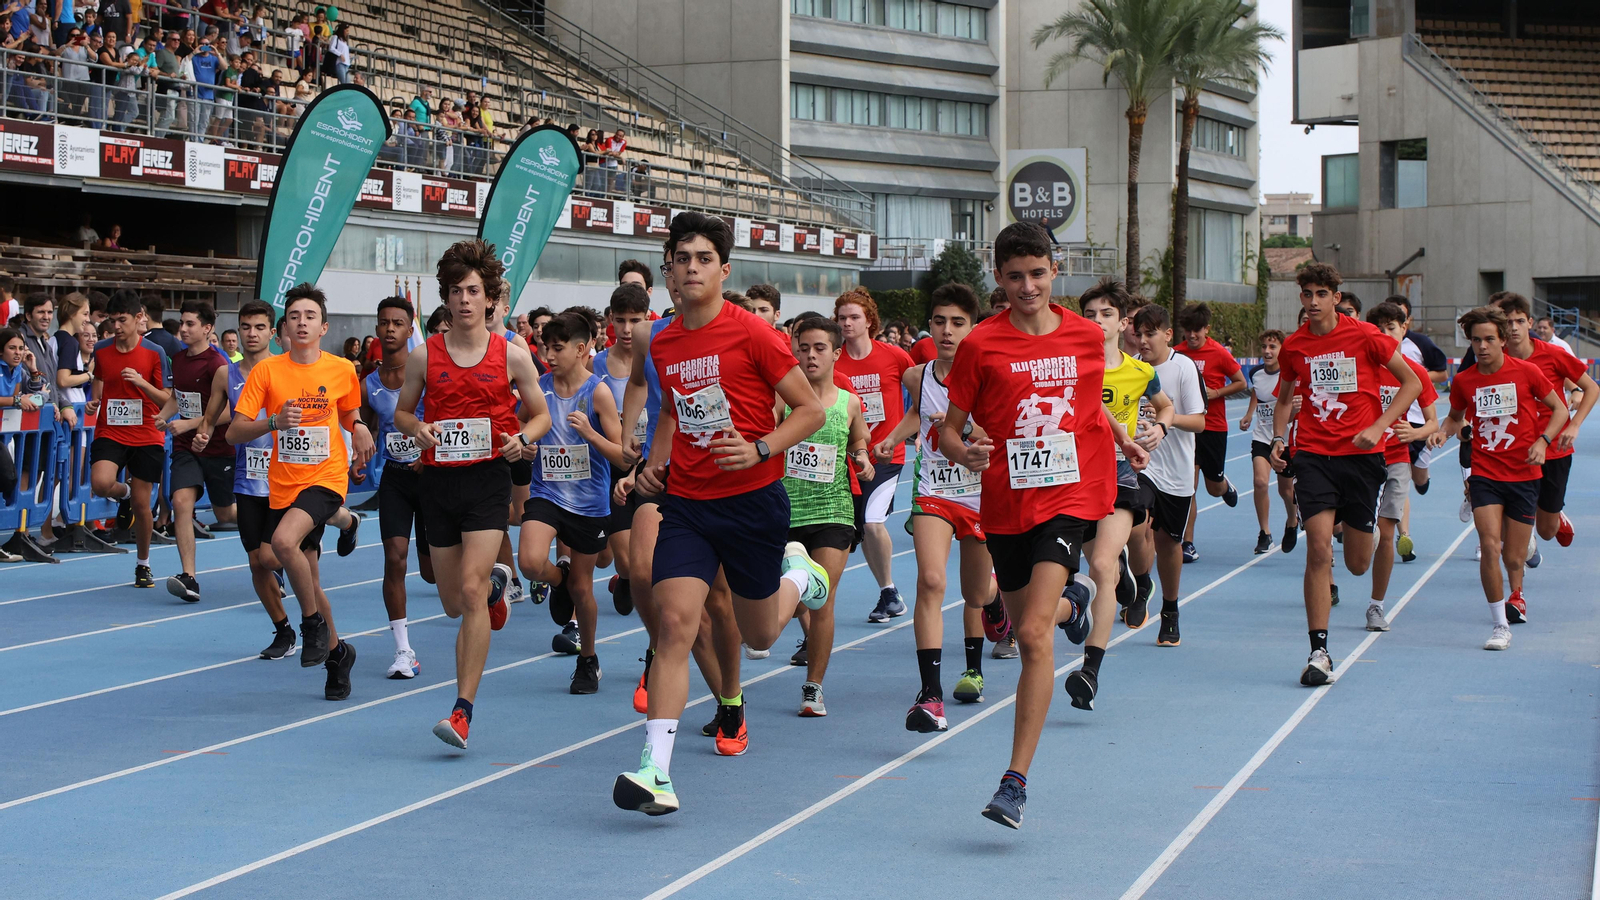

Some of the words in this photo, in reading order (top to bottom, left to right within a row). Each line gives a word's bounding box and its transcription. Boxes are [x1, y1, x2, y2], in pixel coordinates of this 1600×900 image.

[316, 121, 374, 146] ESPROHIDENT
[70, 144, 95, 154] Ayuntamiento
[310, 129, 374, 155] www.esprohident.com
[105, 144, 137, 164] PLAY
[131, 143, 173, 176] JEREZ
[198, 160, 220, 168] Ayuntamiento
[228, 160, 256, 179] PLAY
[515, 164, 568, 188] www.esprohident.com
[520, 157, 569, 180] ESPROHIDENT
[424, 186, 446, 202] PLAY
[441, 184, 468, 210] JEREZ
[1014, 182, 1072, 208] B&B
[573, 205, 590, 219] PLAY
[1022, 209, 1063, 218] HOTELS
[272, 152, 340, 310] ESPROHIDENT
[666, 363, 679, 376] XLII
[680, 354, 720, 373] CARRERA
[1010, 362, 1029, 373] XLII
[1029, 356, 1077, 370] CARRERA
[680, 365, 720, 384] POPULAR
[851, 373, 880, 382] CARRERA
[1031, 366, 1078, 381] POPULAR
[1313, 368, 1339, 381] 1390
[1478, 394, 1501, 407] 1378
[108, 406, 129, 416] 1792
[280, 436, 310, 451] 1585
[388, 440, 415, 452] 1384
[437, 430, 469, 446] 1478
[248, 456, 270, 469] 1713
[543, 455, 570, 468] 1600
[789, 450, 818, 468] 1363
[1011, 450, 1051, 470] 1747
[930, 468, 961, 484] 1471
